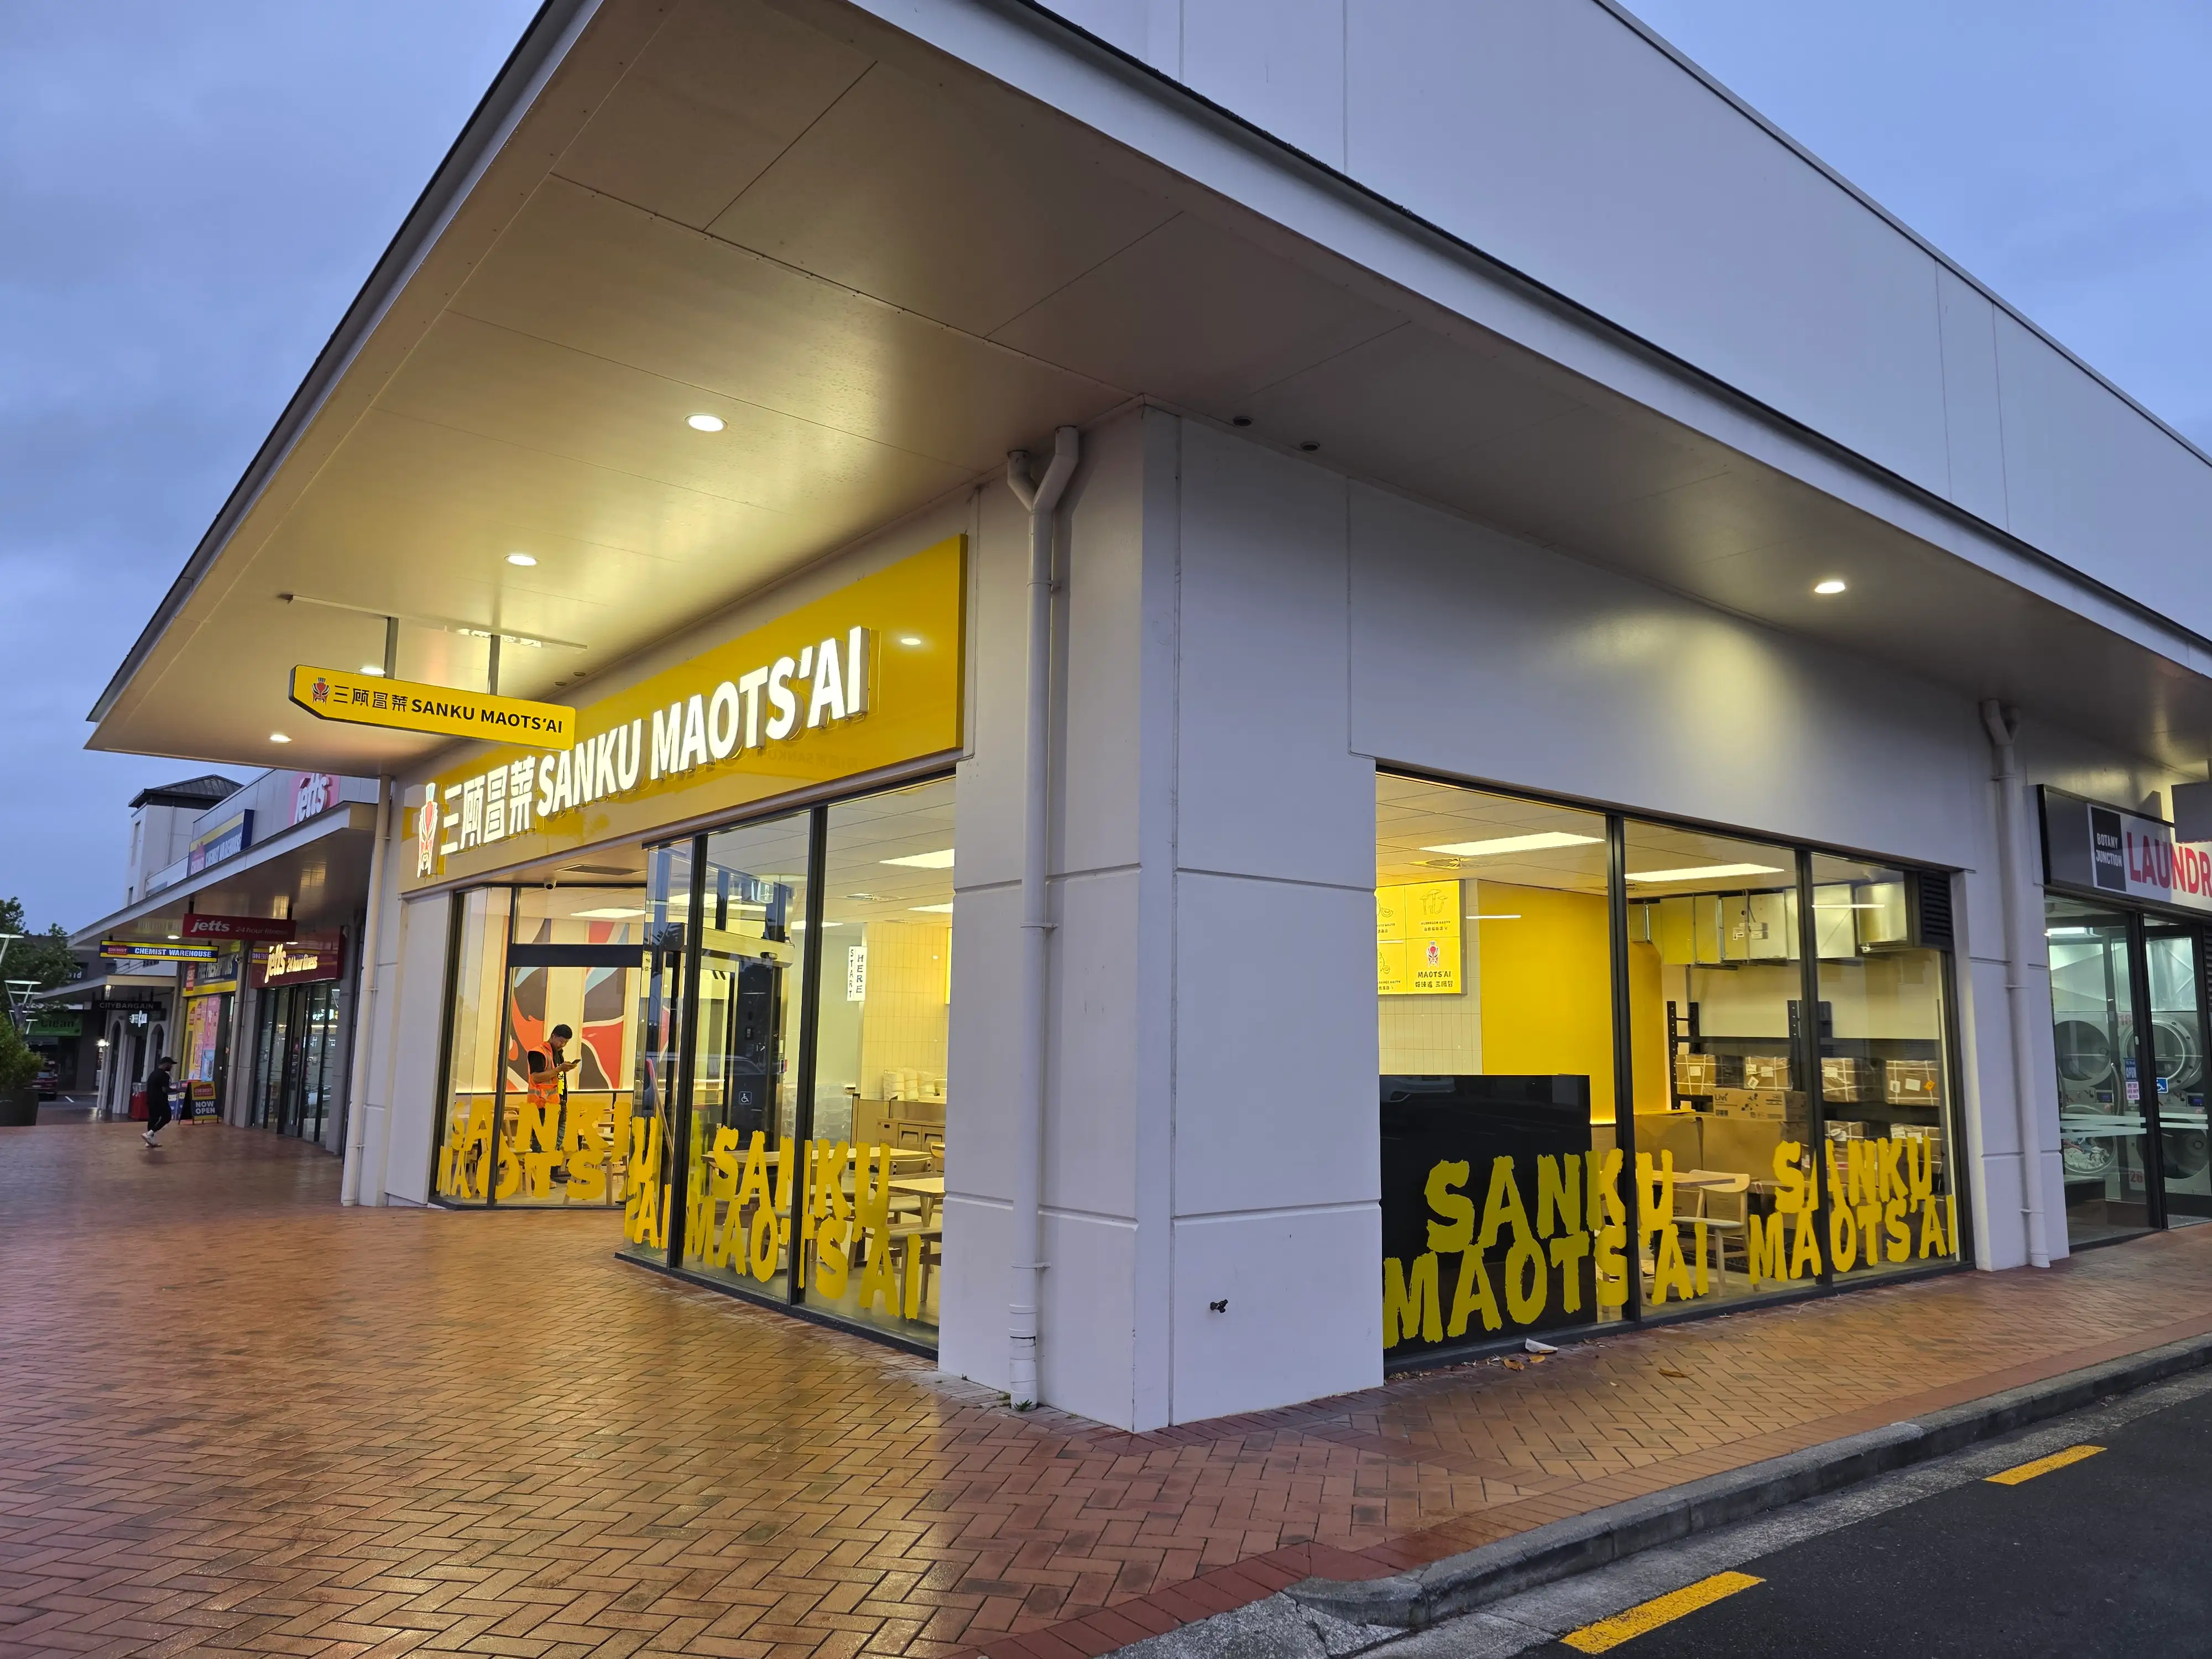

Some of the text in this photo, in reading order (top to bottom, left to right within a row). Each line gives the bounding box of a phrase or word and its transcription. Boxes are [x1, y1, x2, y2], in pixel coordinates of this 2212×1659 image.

[411, 698, 562, 734] SANKU MAOTS'AI
[536, 626, 864, 817] SANKU MAOTS'AI
[2096, 833, 2118, 849] BOTANY
[2096, 850, 2122, 867] JUNCTION
[2126, 831, 2212, 898] LAUNDR
[191, 920, 230, 932] jetts
[135, 947, 212, 957] CHEMIST WAREHOUSE
[265, 943, 286, 983] jetts
[855, 954, 864, 994] HERE
[712, 1125, 890, 1218] SANKU
[1772, 1135, 1932, 1214] SANKU
[1425, 1148, 1673, 1253] SANKU
